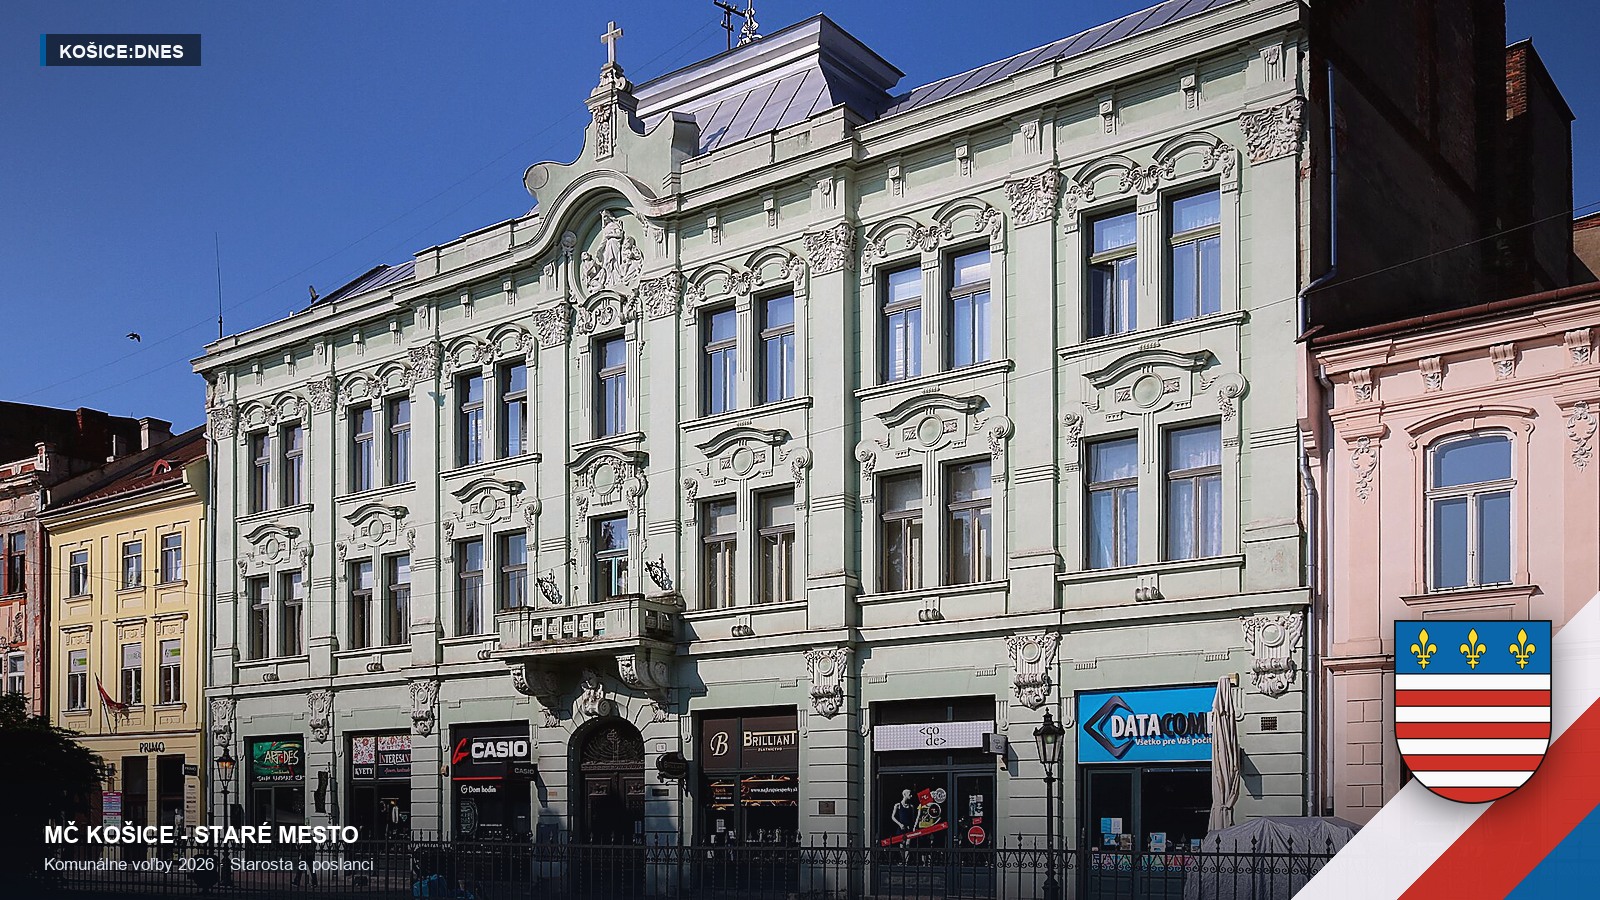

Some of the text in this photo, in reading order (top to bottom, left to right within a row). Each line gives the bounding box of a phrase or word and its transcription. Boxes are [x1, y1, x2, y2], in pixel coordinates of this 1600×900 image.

[710, 731, 729, 756] B
[743, 730, 797, 747] BRILLIANT
[1177, 737, 1190, 745] Váš
[140, 741, 166, 753] PRIMO
[471, 740, 528, 758] CASIO
[355, 767, 374, 775] KVETY
[514, 767, 535, 775] CASIO
